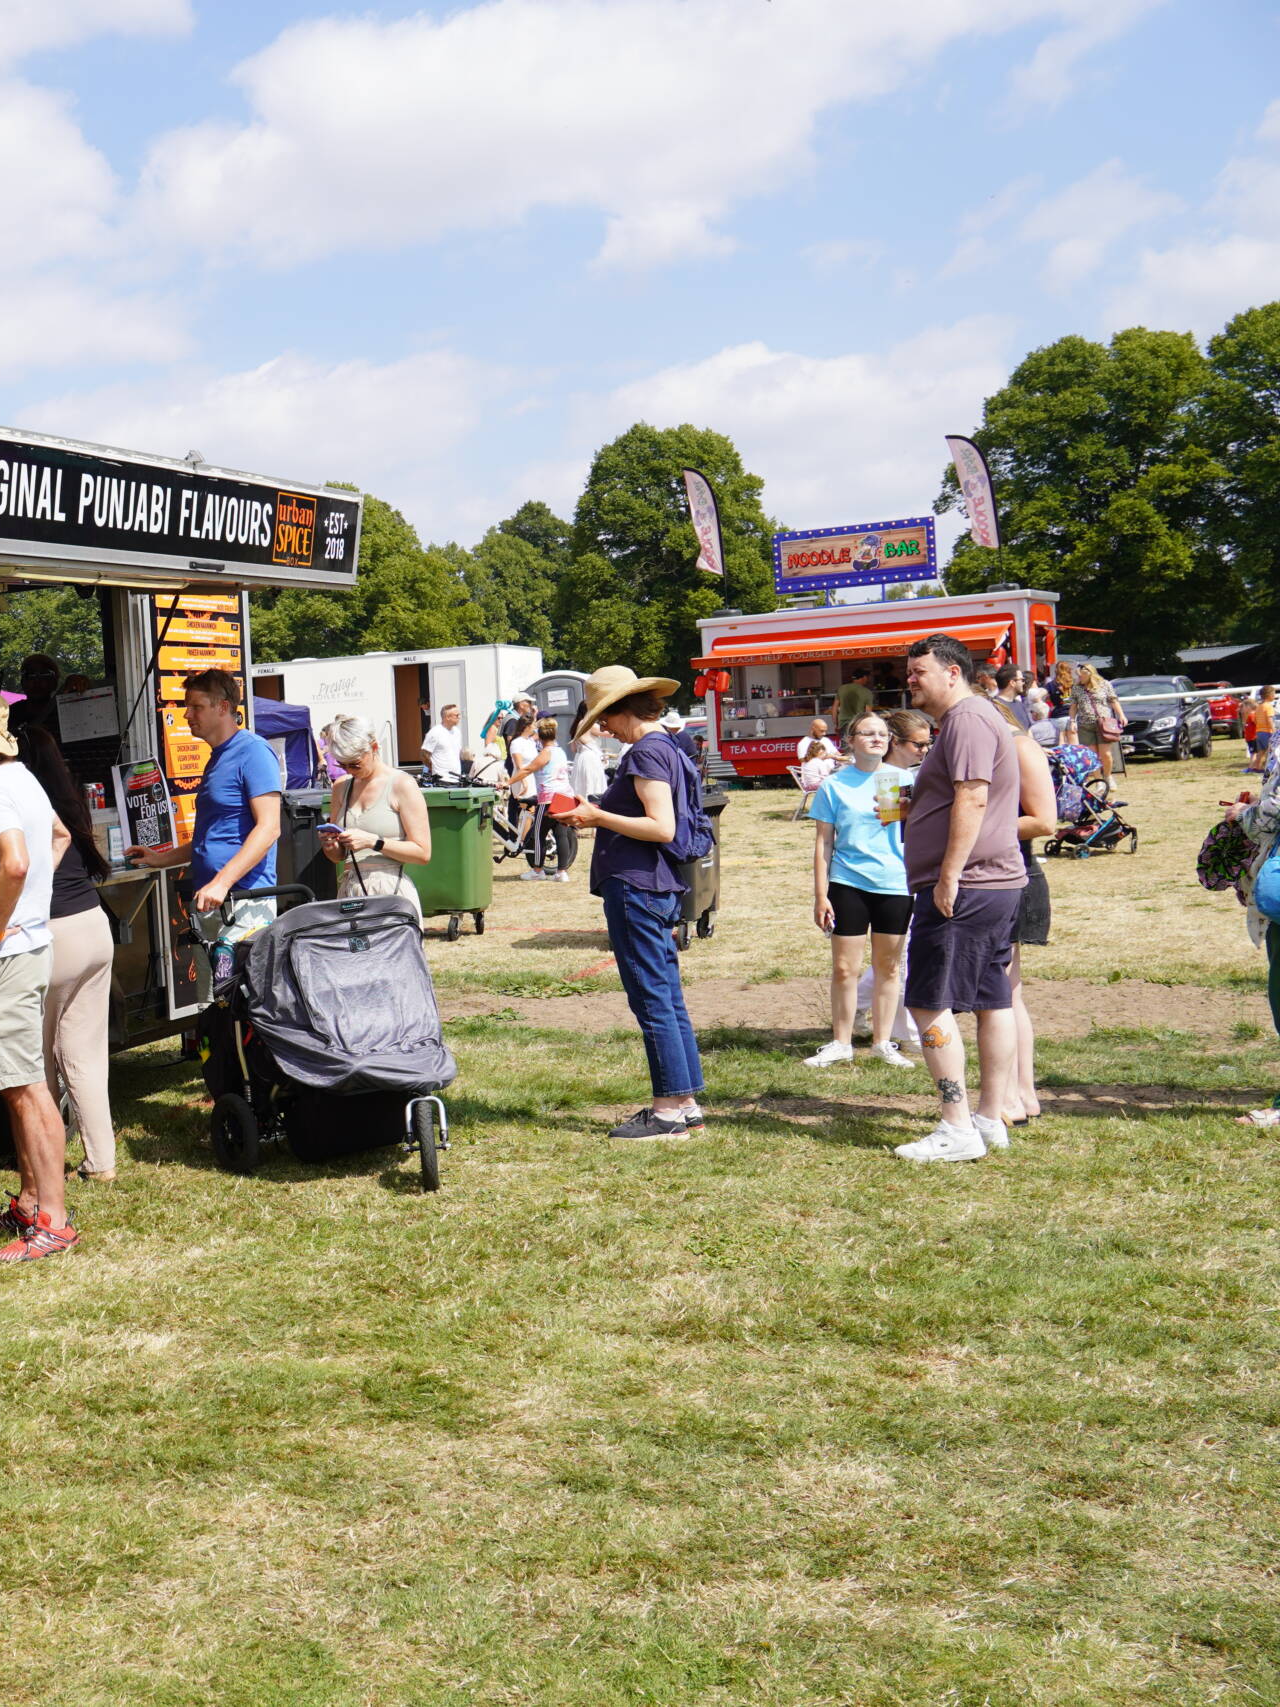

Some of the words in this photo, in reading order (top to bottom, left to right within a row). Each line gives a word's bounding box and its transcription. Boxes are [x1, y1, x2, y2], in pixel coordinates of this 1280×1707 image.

[78, 473, 171, 535] PUNJABI
[179, 490, 271, 548] FLAVOURS
[278, 499, 313, 528] urban
[329, 511, 345, 533] EST
[276, 523, 312, 556] SPICE
[324, 537, 345, 561] 2018
[786, 546, 851, 569] NOODLE
[883, 540, 921, 560] BAR
[721, 656, 756, 664] PLEASE
[730, 745, 747, 754] TEA
[760, 743, 796, 753] COFFEE
[127, 793, 149, 809] VOTE
[141, 804, 157, 819] FOR
[157, 800, 169, 815] US!
